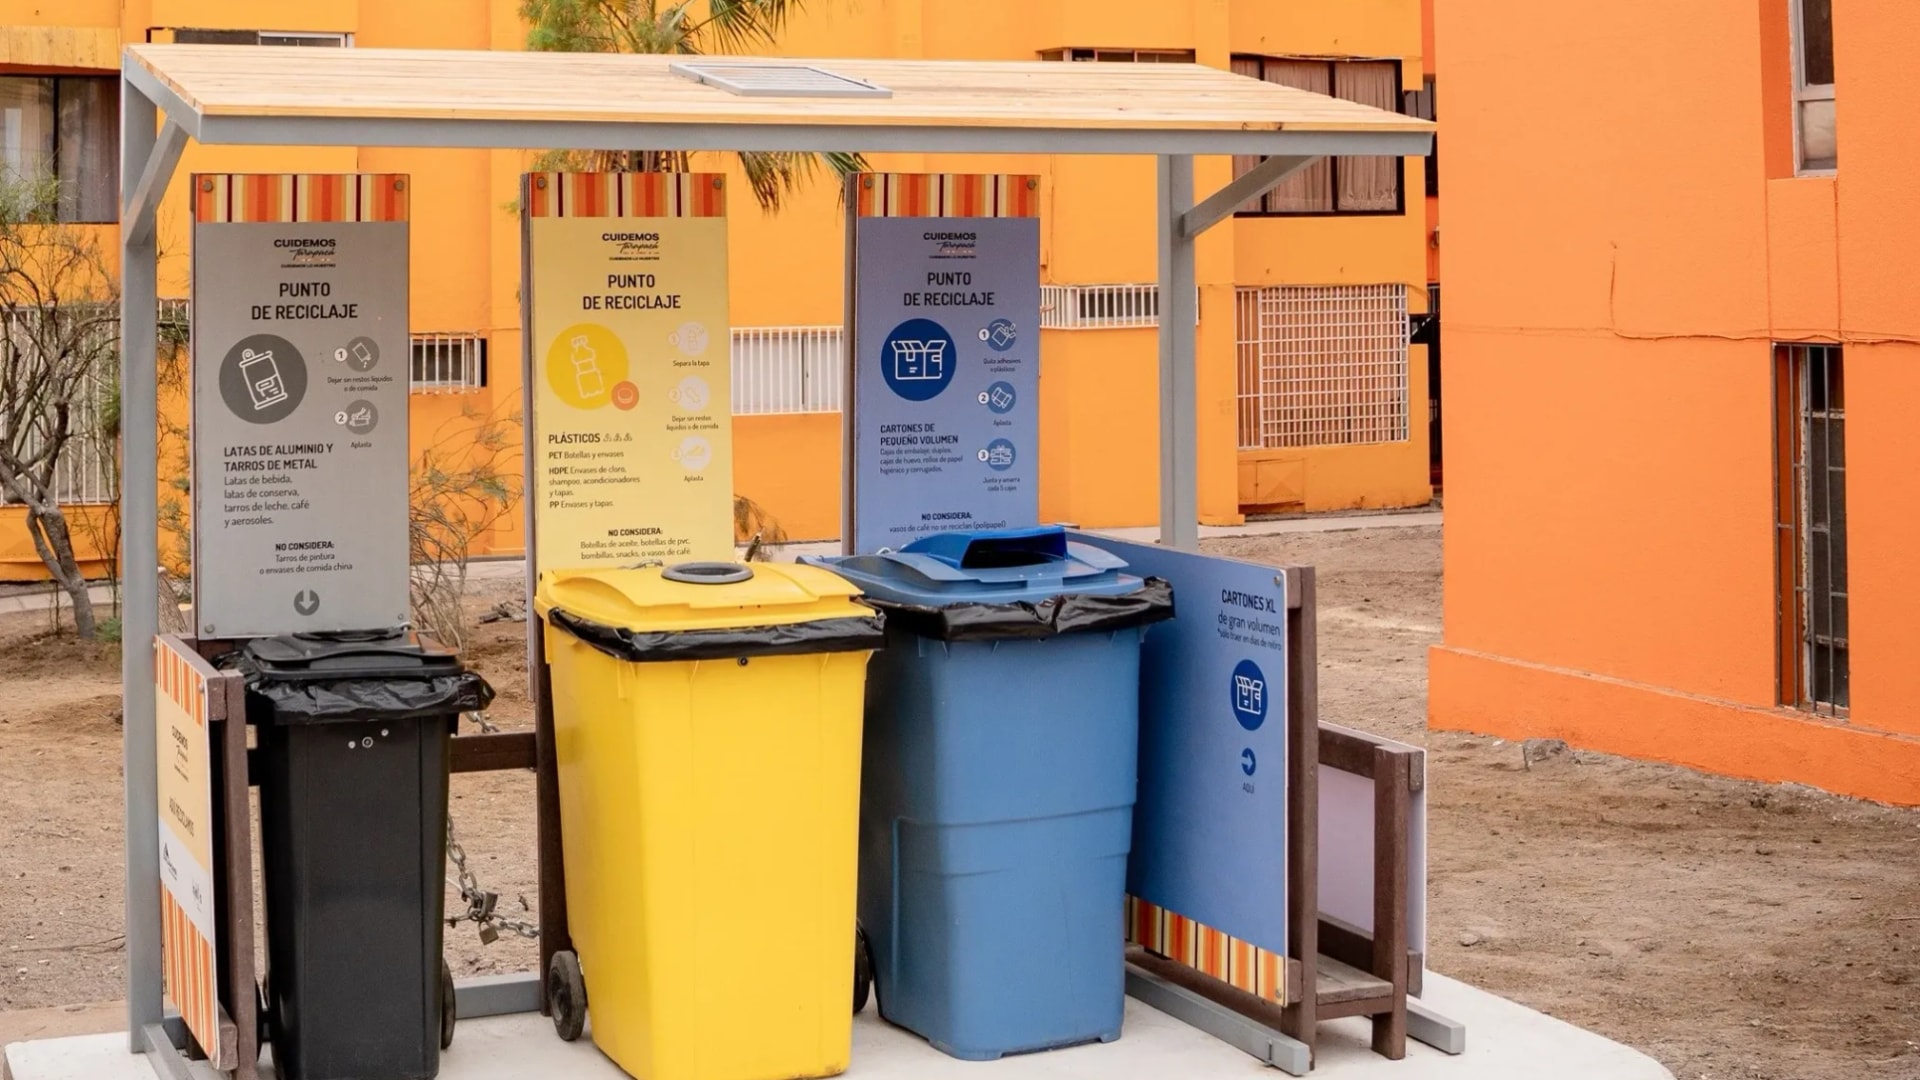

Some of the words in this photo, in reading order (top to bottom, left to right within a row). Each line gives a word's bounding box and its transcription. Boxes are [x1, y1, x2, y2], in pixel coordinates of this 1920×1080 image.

[602, 233, 660, 241] CUIDEMOS
[923, 232, 977, 241] CUIDEMOS
[274, 239, 336, 248] CUIDEMOS
[608, 274, 656, 288] PUNTO
[927, 272, 972, 286] PUNTO
[279, 282, 331, 298] PUNTO
[583, 296, 601, 310] DE
[605, 295, 681, 310] RECICLAJE
[904, 293, 921, 306] DE
[924, 292, 995, 306] RECICLAJE
[252, 305, 272, 320] DE
[276, 304, 358, 320] RECICLAJE
[338, 351, 344, 359] 1
[673, 360, 692, 368] Separa
[698, 360, 710, 368] tapa
[327, 377, 342, 385] Dejar
[357, 384, 378, 392] comida
[338, 414, 344, 422] 2
[672, 415, 686, 423] Dejar
[880, 424, 923, 433] CARTONES
[925, 423, 936, 433] DE
[548, 432, 601, 444] PLÁSTICOS
[880, 434, 918, 446] PEQUEÑO
[920, 435, 959, 445] VOLUMEN
[224, 446, 258, 457] LATAS
[260, 445, 273, 456] DE
[275, 444, 324, 455] ALUMINIO
[326, 443, 334, 454] Y
[351, 441, 372, 449] Aplasta
[548, 451, 562, 460] PET
[564, 451, 590, 460] Botellas
[880, 448, 895, 456] Cajas
[224, 461, 265, 472] TARROS
[267, 460, 281, 471] DE
[283, 459, 318, 470] METAL
[880, 459, 894, 467] cajas
[895, 457, 903, 465] de
[947, 455, 964, 463] papel
[548, 467, 569, 475] HDPE
[570, 466, 598, 474] Envases
[224, 476, 248, 486] Latas
[249, 475, 261, 485] de
[262, 474, 293, 484] bebida,
[583, 476, 641, 485] acondicionadores
[683, 475, 704, 483] Aplasta
[224, 490, 245, 499] latas
[247, 489, 258, 498] de
[259, 489, 300, 498] conserva,
[224, 504, 250, 513] tarros
[252, 502, 263, 512] de
[265, 501, 290, 511] leche,
[291, 499, 310, 510] café
[550, 501, 560, 509] PP
[561, 501, 588, 509] Envases
[589, 501, 594, 509] y
[922, 513, 932, 521] NO
[933, 512, 973, 520] CONSIDERA:
[224, 519, 230, 529] y
[232, 515, 274, 526] aerosoles.
[890, 525, 907, 533] vasos
[917, 524, 929, 532] café
[949, 522, 972, 530] reciclan
[973, 520, 1006, 530] (polipapel)
[620, 528, 663, 536] CONSIDERA:
[276, 543, 287, 552] NO
[288, 541, 335, 551] CONSIDERA:
[581, 541, 607, 549] Botellas
[608, 540, 617, 548] de
[641, 538, 667, 546] botellas
[667, 548, 676, 556] de
[276, 554, 298, 563] Tarros
[299, 553, 308, 562] de
[310, 553, 335, 562] pintura
[296, 565, 305, 573] de
[306, 563, 332, 572] comida
[334, 562, 353, 571] china
[1222, 588, 1264, 611] CARTONES
[1265, 597, 1277, 614] XL
[1218, 609, 1228, 625] de
[1229, 616, 1246, 631] gran
[1247, 617, 1281, 637] volumen
[1261, 637, 1267, 648] de
